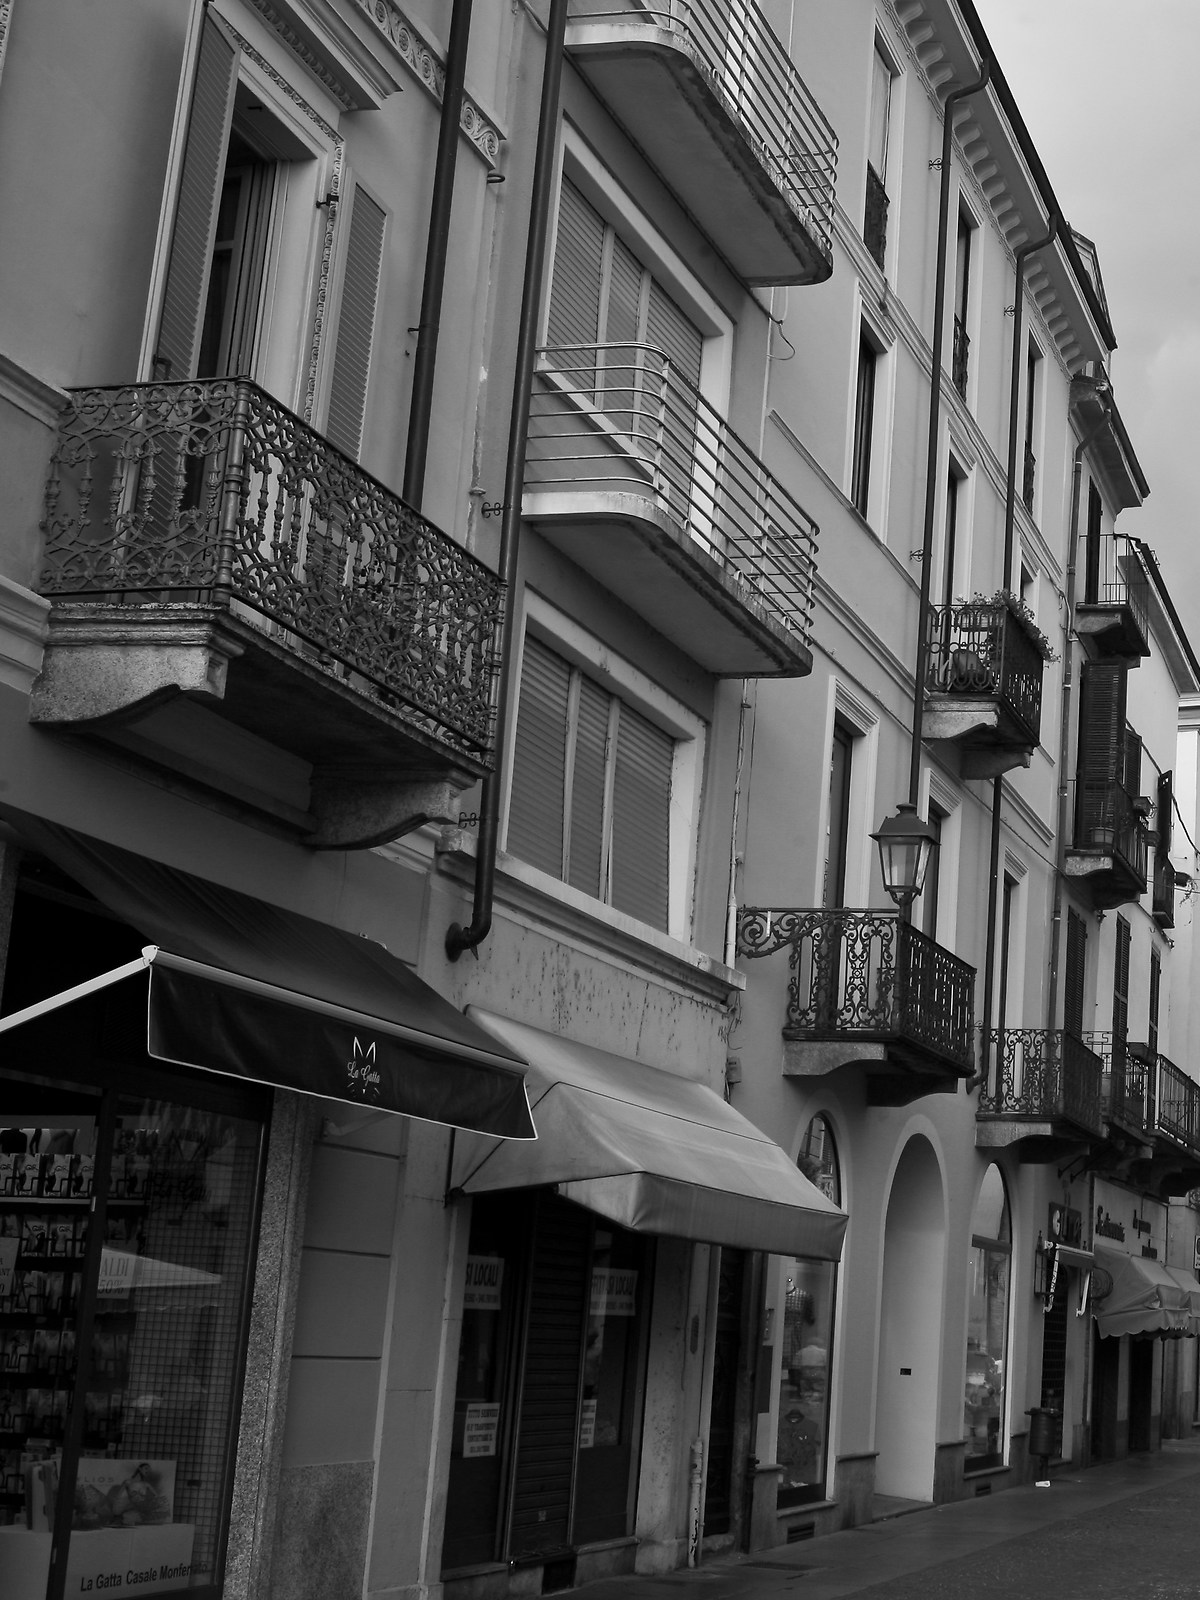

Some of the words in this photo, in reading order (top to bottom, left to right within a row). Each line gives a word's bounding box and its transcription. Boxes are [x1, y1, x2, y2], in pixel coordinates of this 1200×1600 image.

[100, 1256, 129, 1277] ALDI
[81, 1577, 93, 1592] La
[96, 1573, 122, 1589] Gatta
[126, 1568, 157, 1585] Casale
